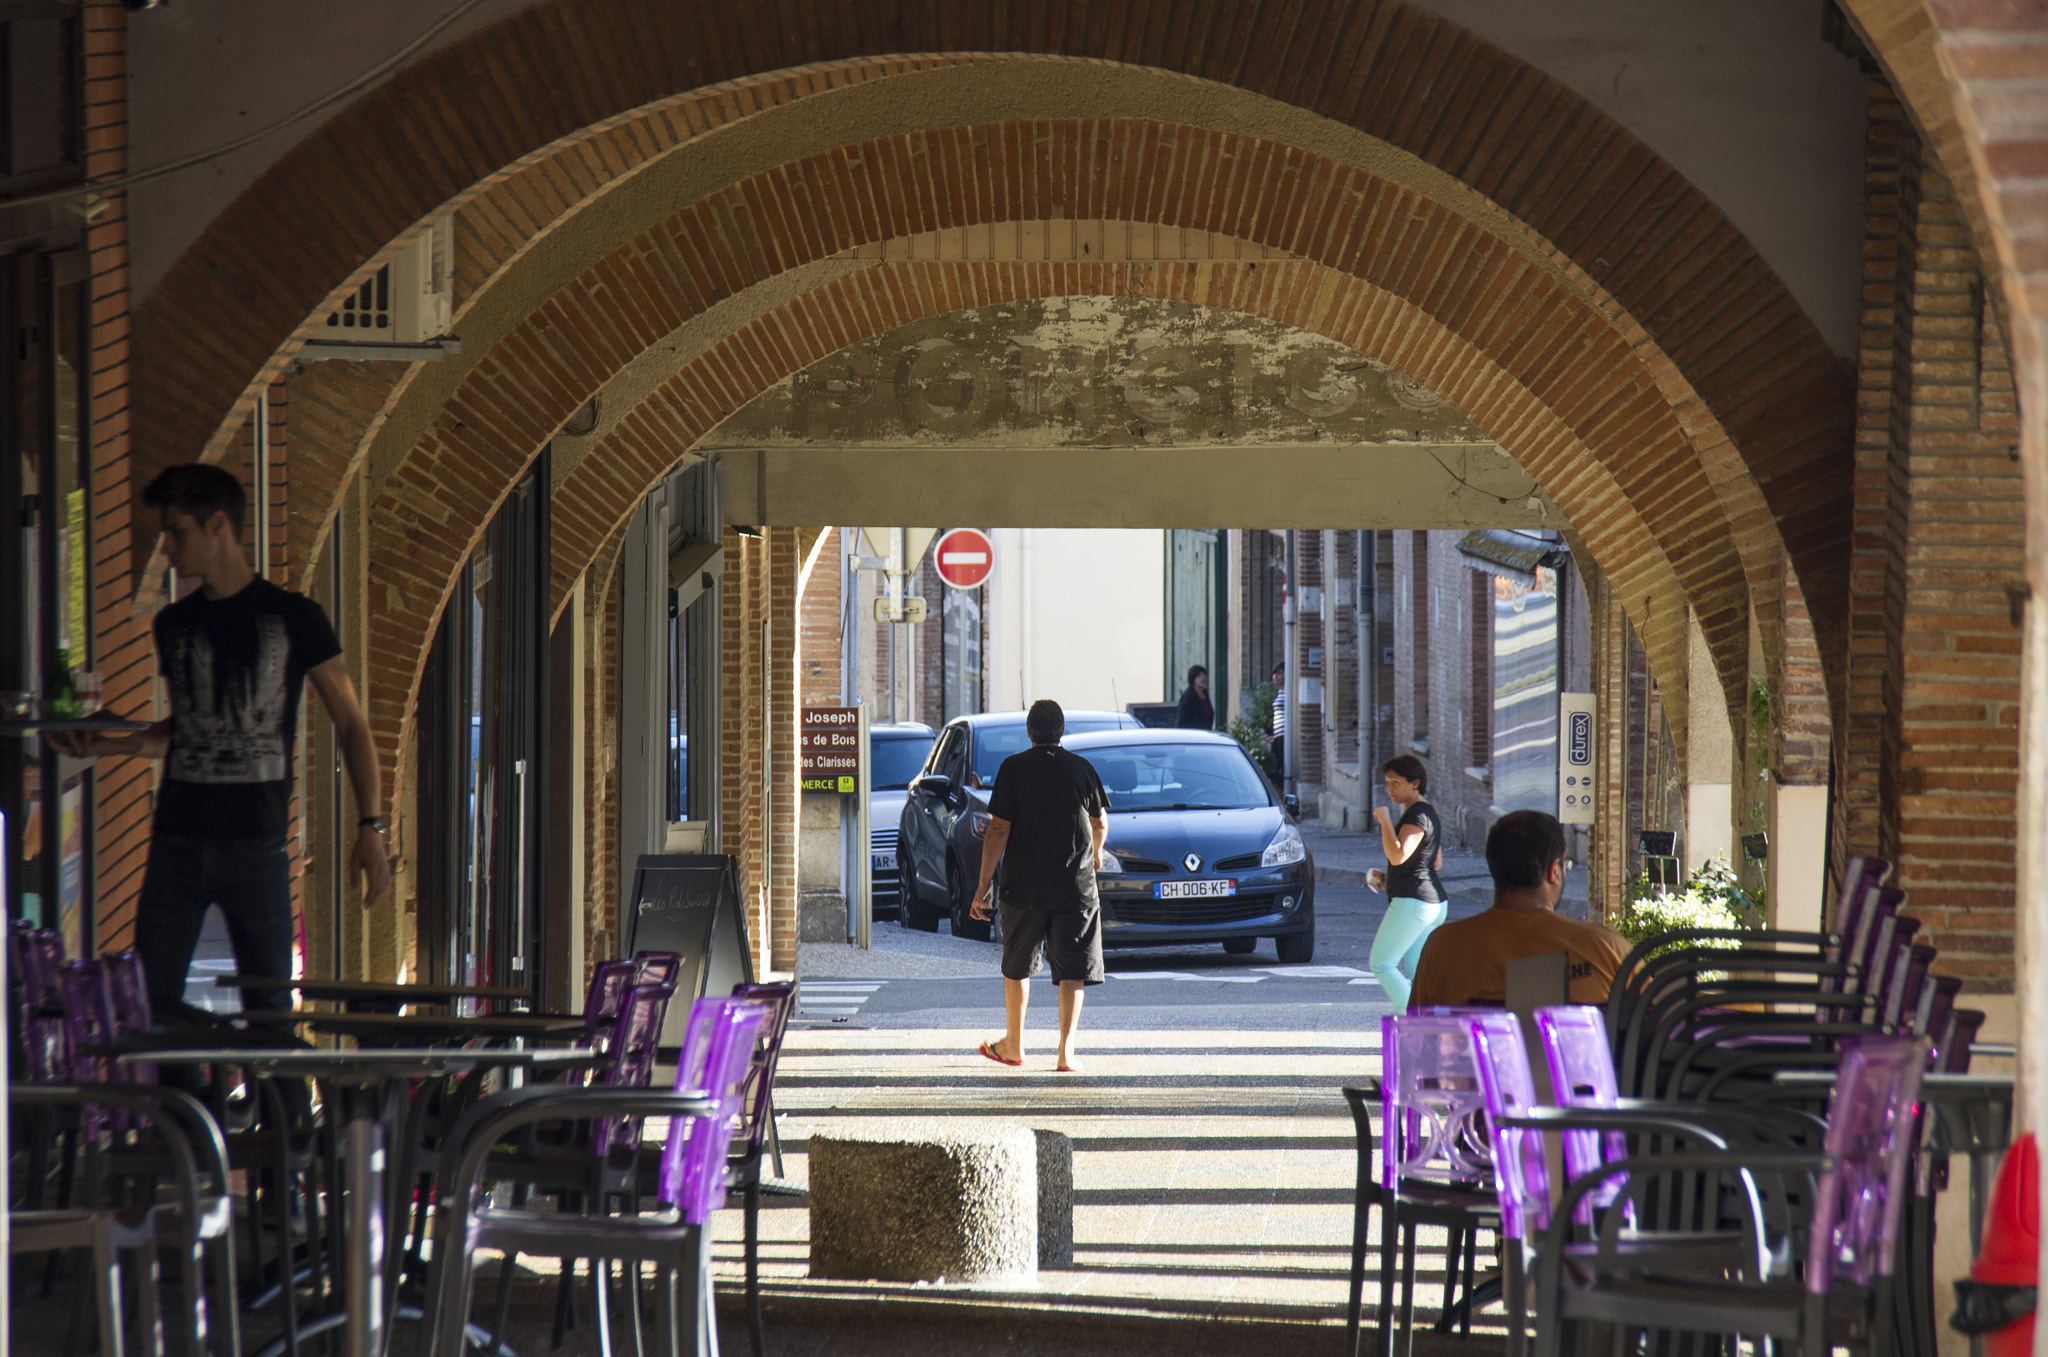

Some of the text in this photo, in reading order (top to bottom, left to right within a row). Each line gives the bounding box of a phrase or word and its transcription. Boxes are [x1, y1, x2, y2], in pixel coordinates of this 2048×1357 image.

[805, 711, 856, 725] Joseph
[813, 733, 827, 745] de
[831, 733, 856, 745] Bois
[1572, 715, 1590, 760] durex
[817, 755, 857, 768] Clarisses
